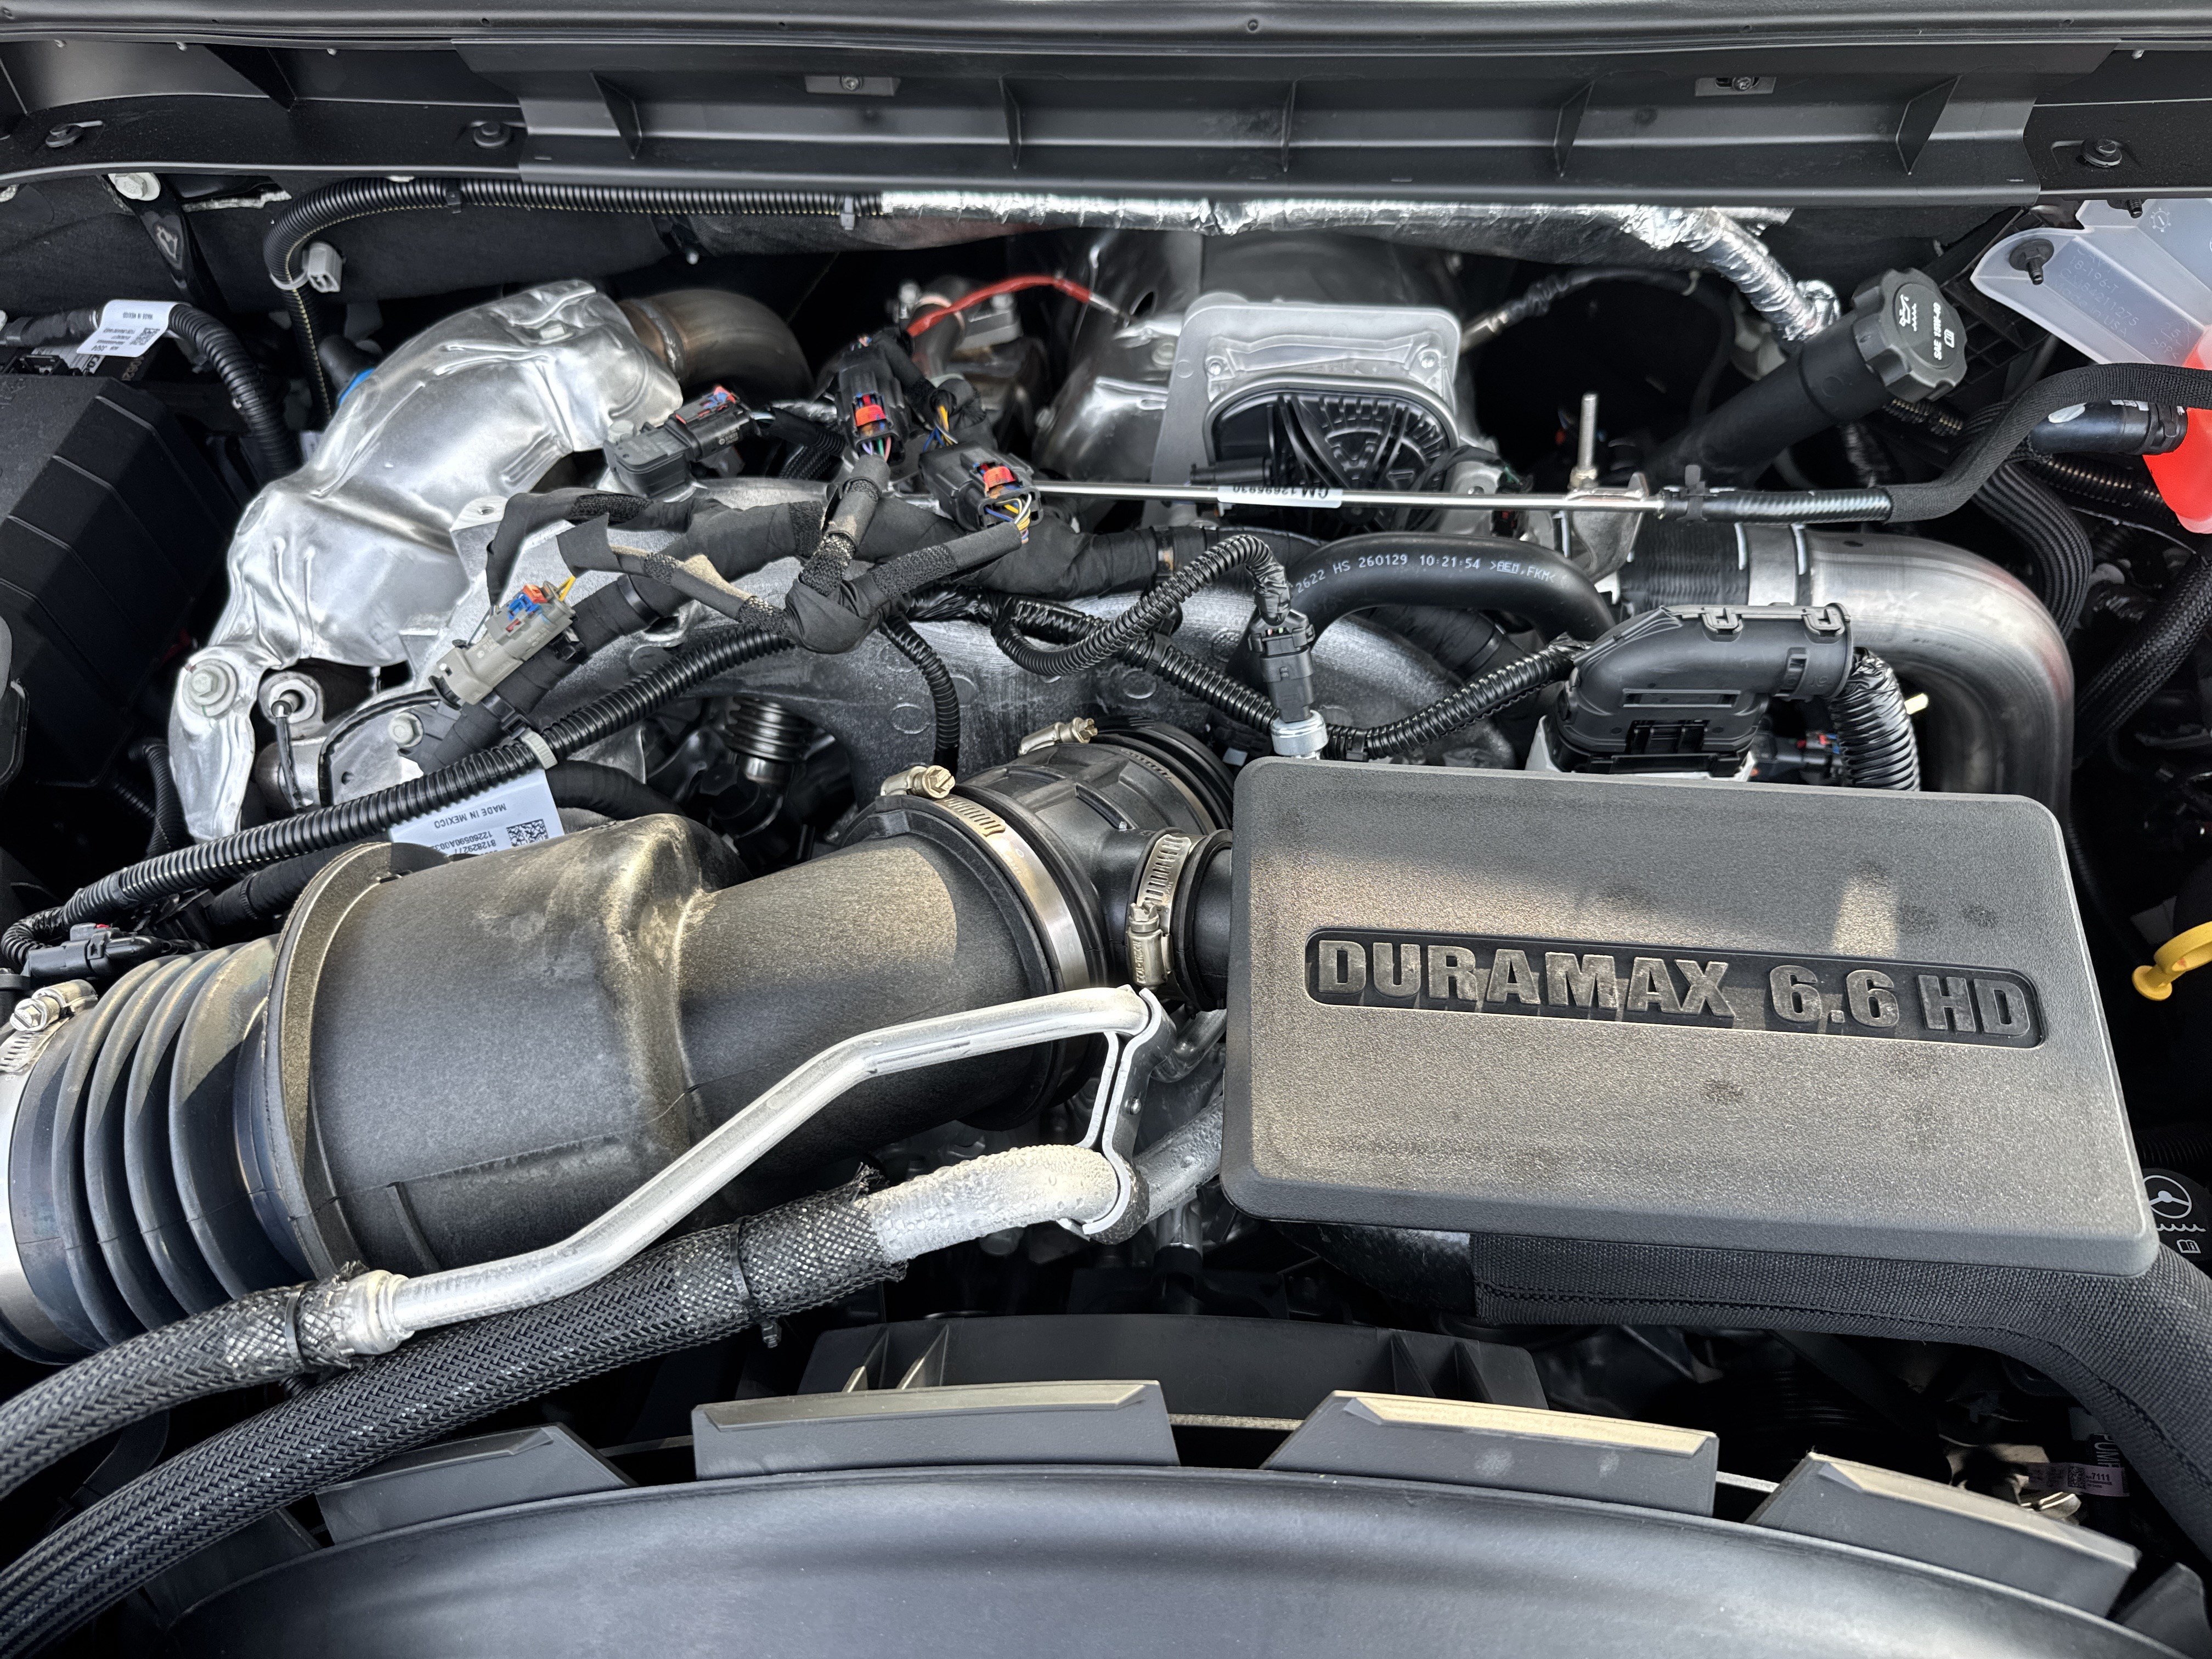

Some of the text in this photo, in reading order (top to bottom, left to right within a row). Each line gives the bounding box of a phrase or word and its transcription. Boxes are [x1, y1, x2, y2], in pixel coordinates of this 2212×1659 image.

[2103, 317, 2129, 338] USA
[1934, 339, 1942, 360] SAE
[1296, 569, 1326, 593] 2622
[1333, 560, 1351, 574] HS
[1358, 554, 1408, 568] 260129
[1419, 555, 1481, 570] 10:21:54
[434, 803, 506, 829] MADE IN MEXICO
[432, 831, 493, 851] 12260590A003
[1318, 938, 2033, 1038] DURAMAX 6.6 HD
